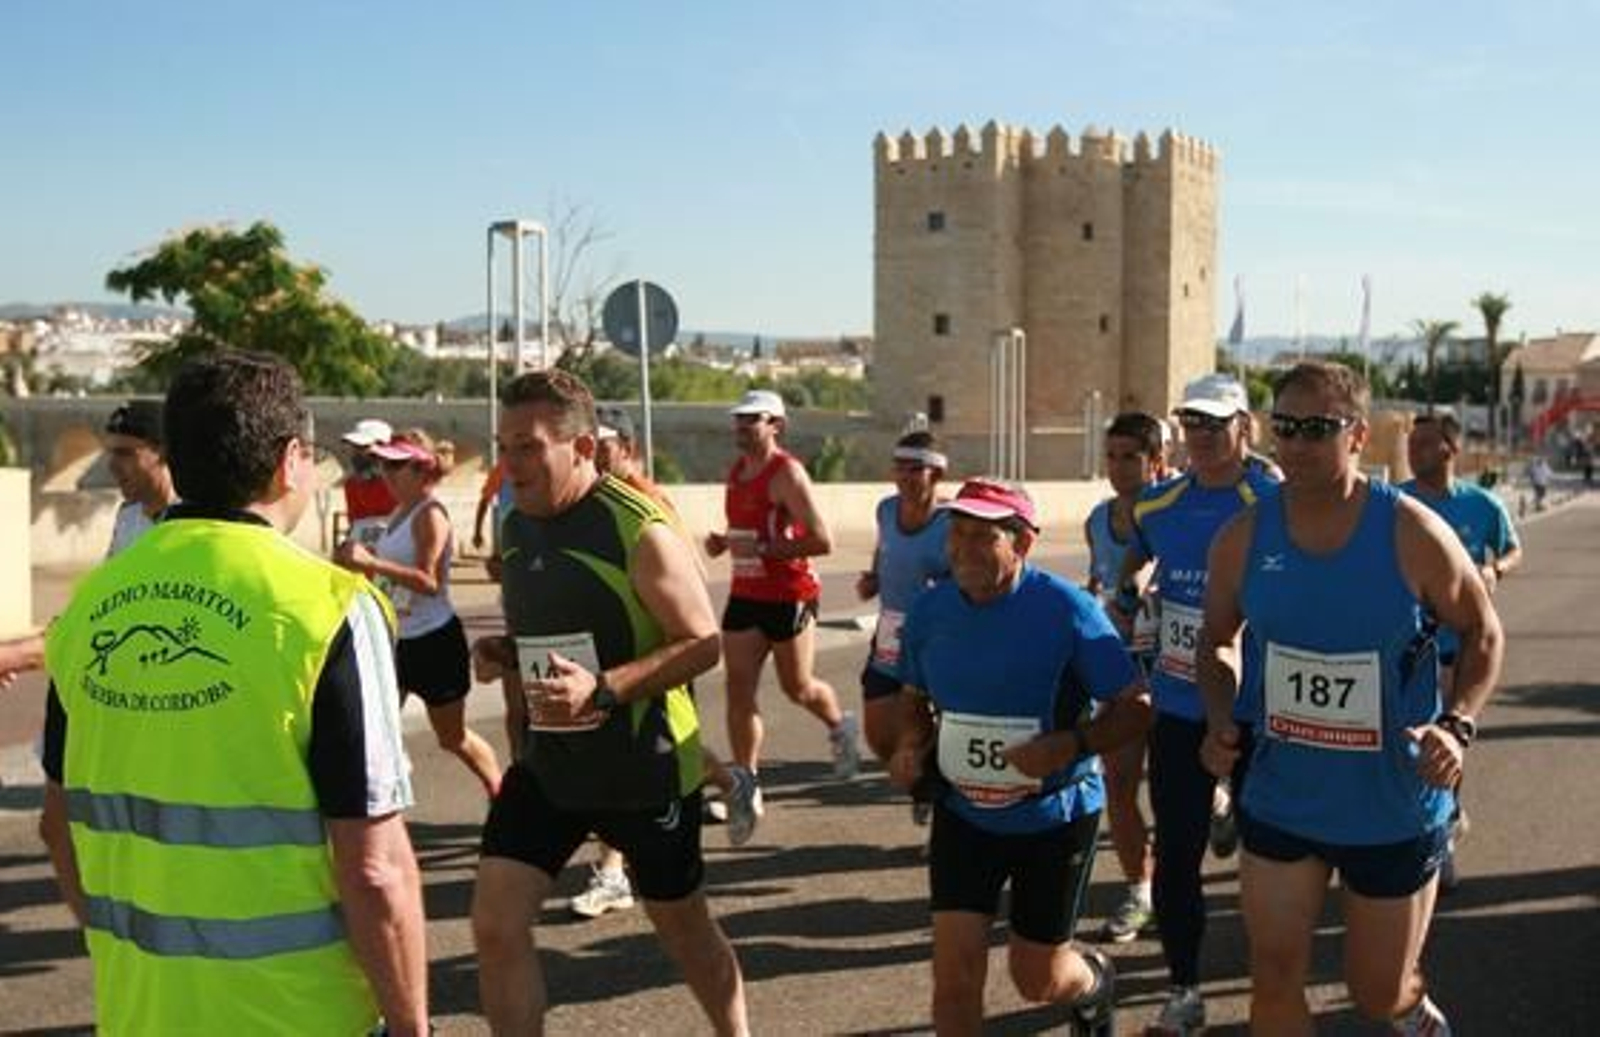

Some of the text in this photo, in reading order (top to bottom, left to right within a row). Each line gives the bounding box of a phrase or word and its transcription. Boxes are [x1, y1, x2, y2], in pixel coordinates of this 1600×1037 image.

[151, 582, 251, 630] MARATON
[150, 680, 233, 711] CORDOBA
[1287, 671, 1357, 708] 187
[967, 738, 1006, 771] 58
